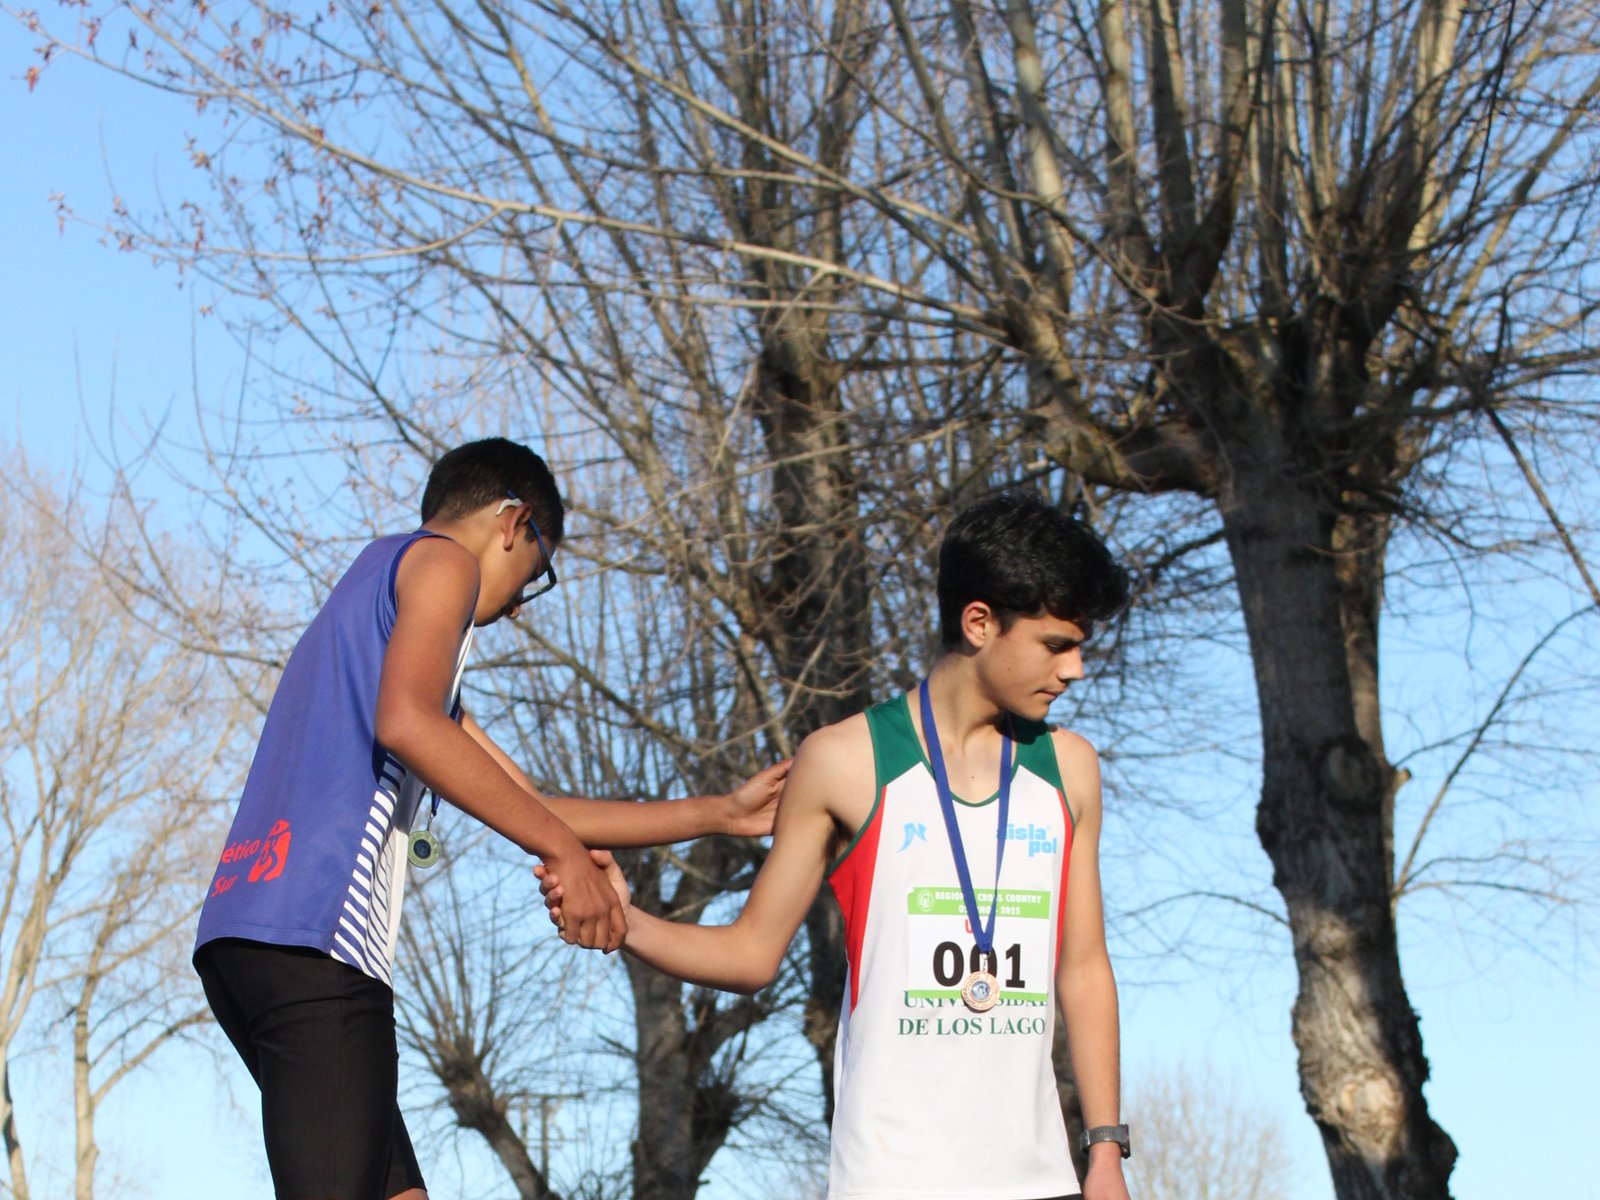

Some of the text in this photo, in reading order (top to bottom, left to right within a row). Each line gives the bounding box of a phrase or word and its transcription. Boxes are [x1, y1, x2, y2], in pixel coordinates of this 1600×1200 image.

[1028, 837, 1057, 857] pol
[1005, 894, 1042, 904] COUNTRY
[933, 941, 1026, 989] 001
[898, 1018, 929, 1035] DE
[936, 1018, 983, 1036] LOS
